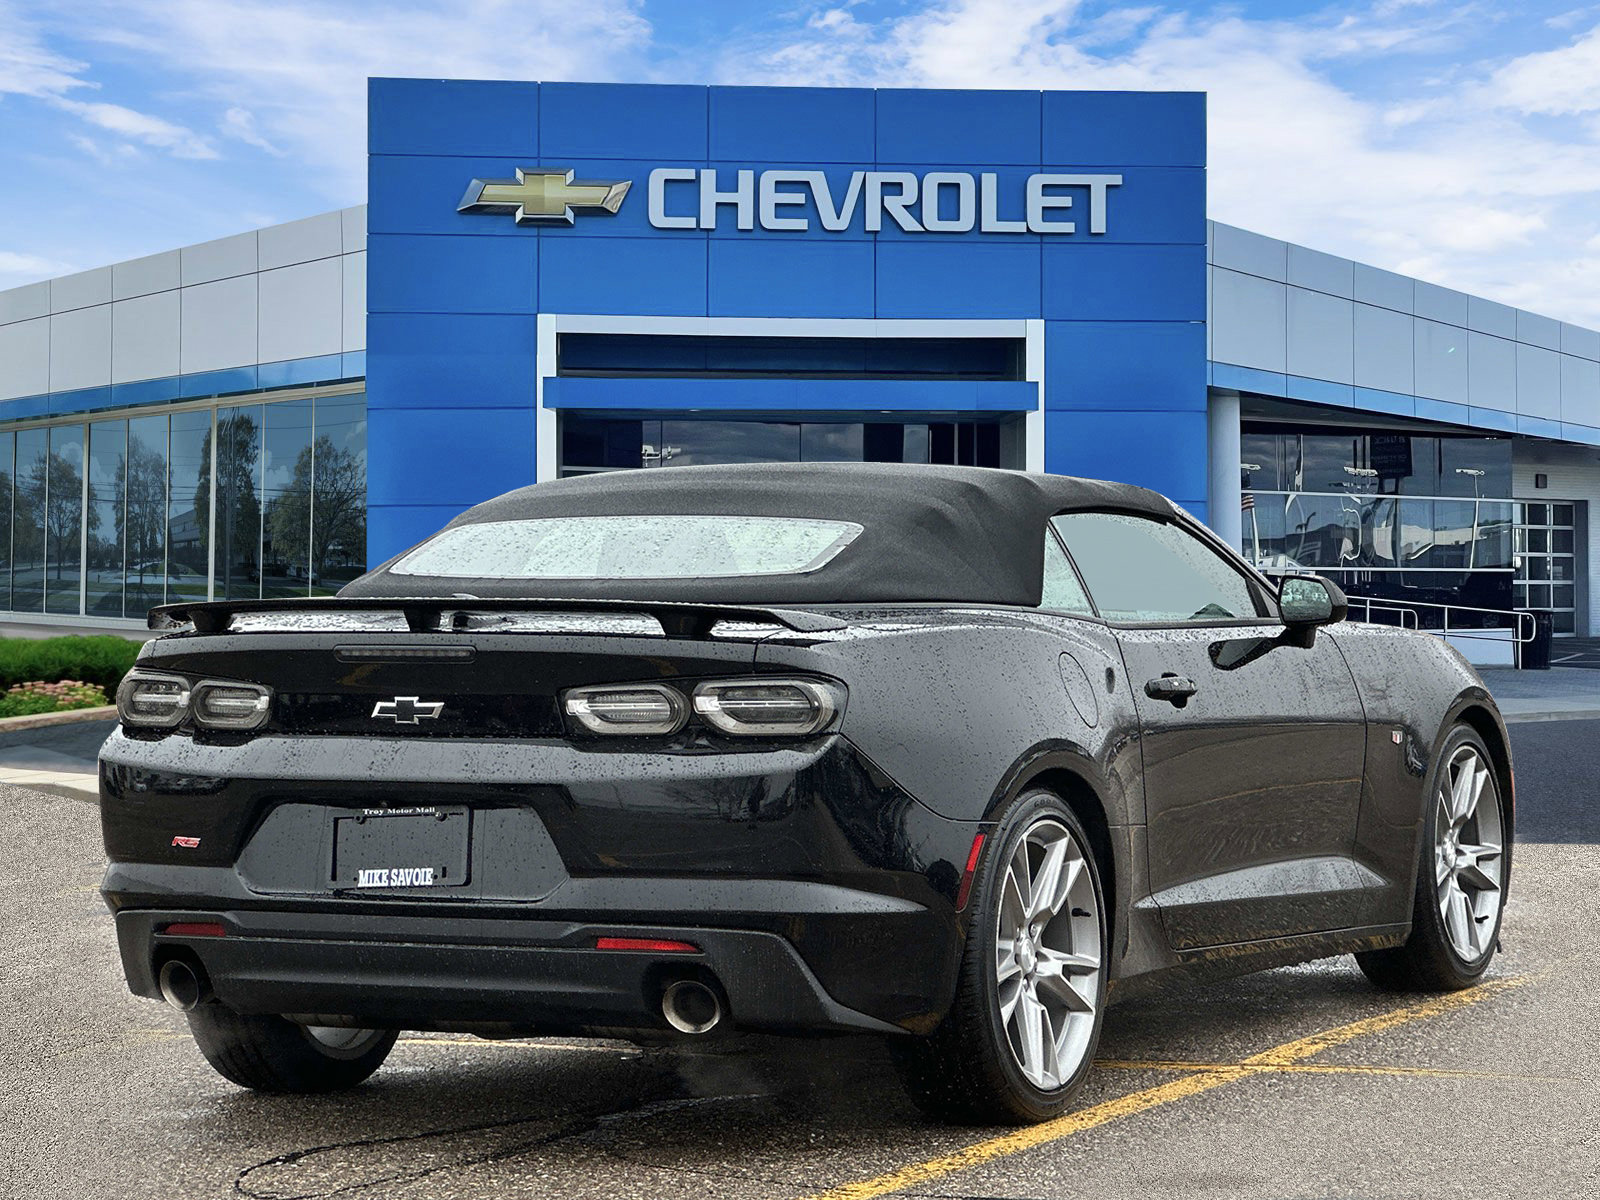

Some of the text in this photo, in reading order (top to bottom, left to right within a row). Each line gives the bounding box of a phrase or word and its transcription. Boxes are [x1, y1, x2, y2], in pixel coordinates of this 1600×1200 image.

[648, 168, 1123, 234] CHEVROLET
[362, 808, 384, 816] Troy
[171, 836, 201, 848] RS
[357, 867, 434, 888] MIKE SAVOIE
